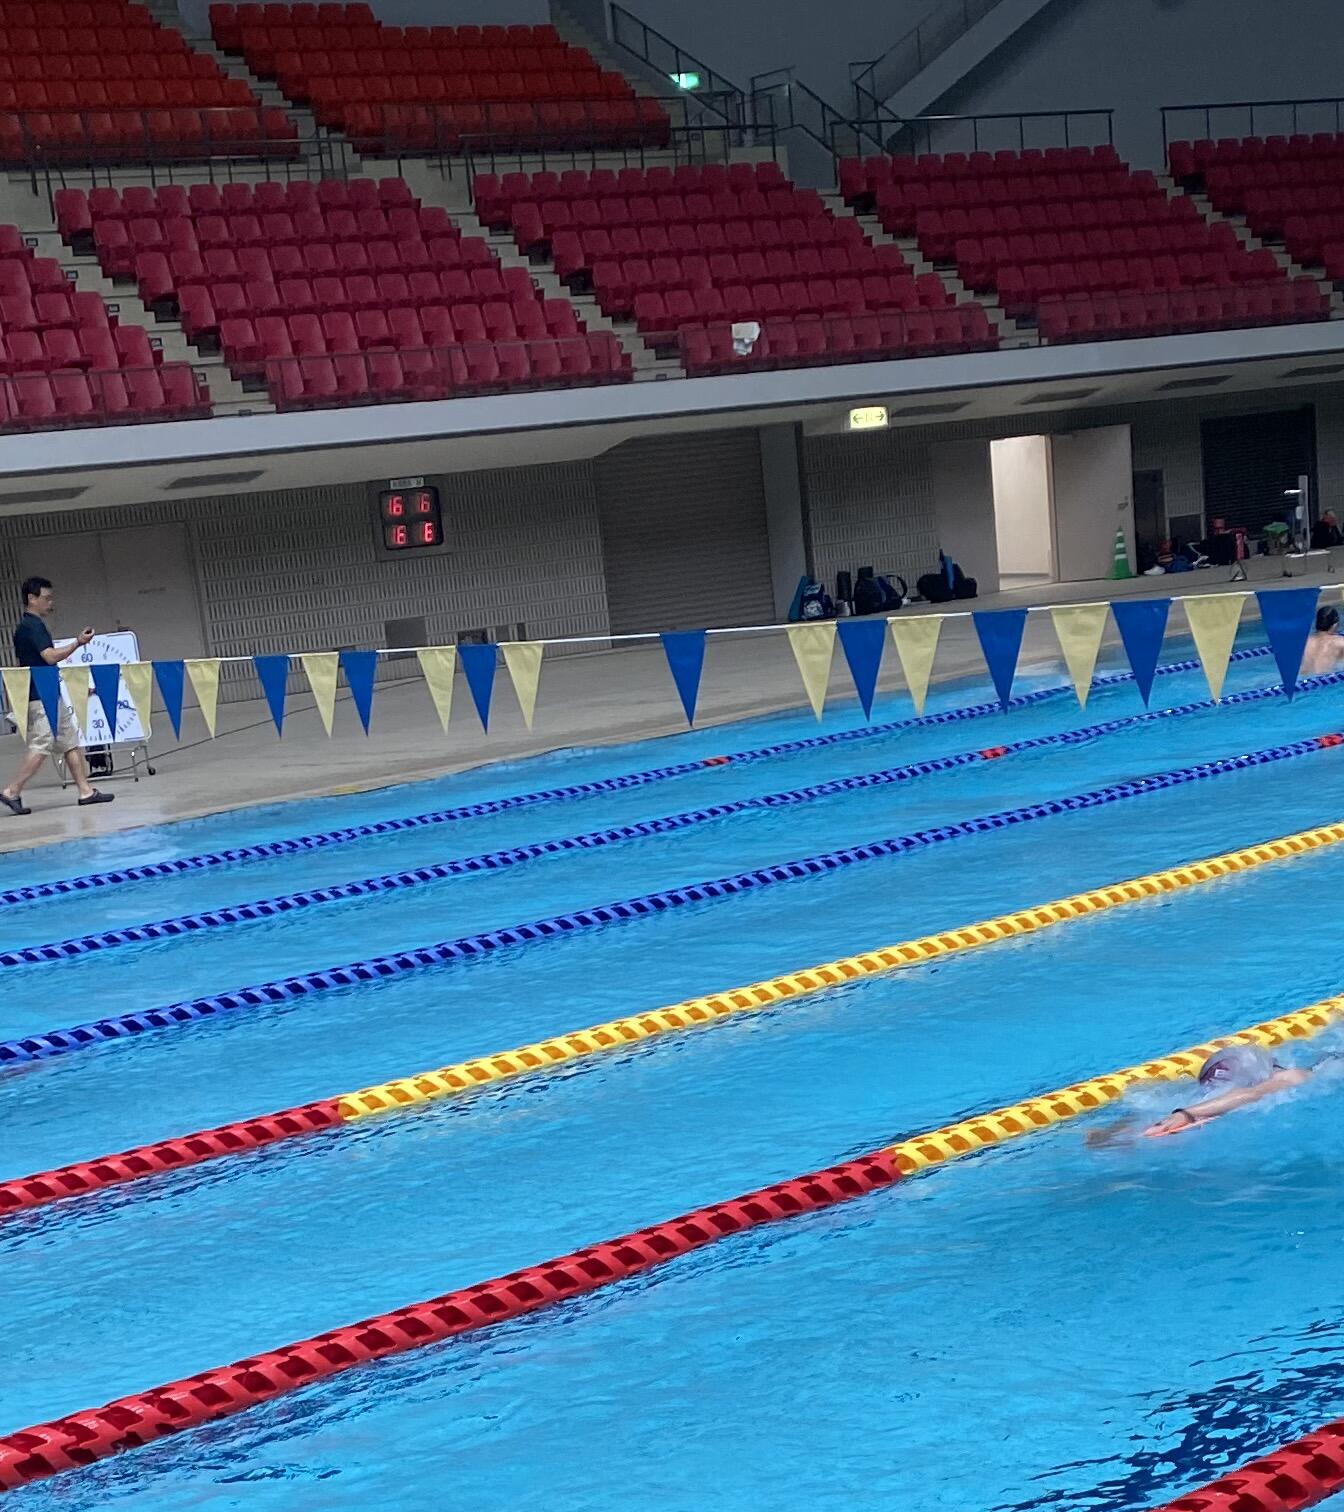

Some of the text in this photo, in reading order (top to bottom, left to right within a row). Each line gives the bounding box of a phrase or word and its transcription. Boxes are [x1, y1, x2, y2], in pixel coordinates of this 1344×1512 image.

[81, 652, 94, 663] 60
[117, 700, 130, 710] 20
[92, 718, 105, 730] 30
